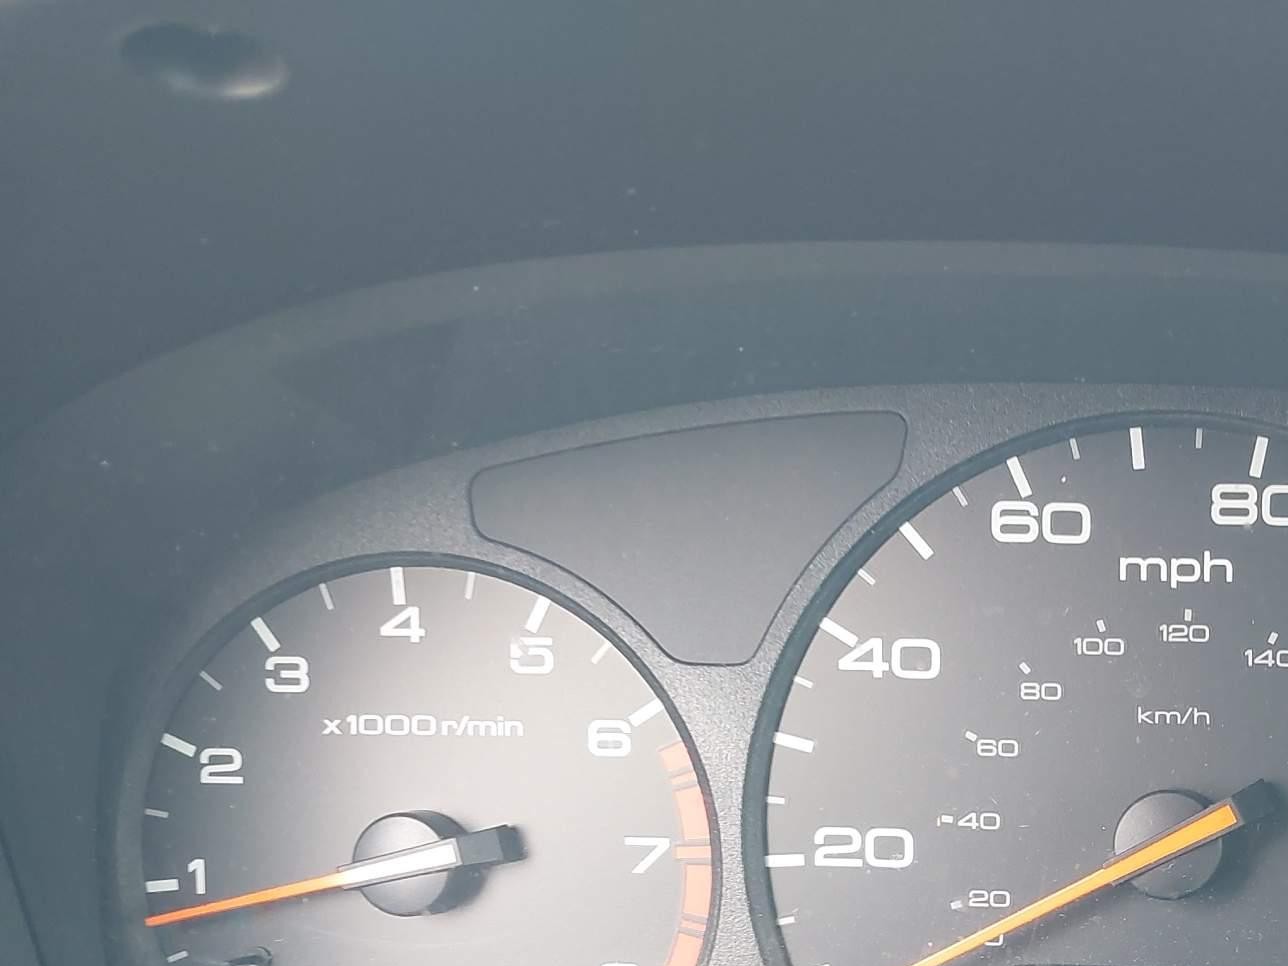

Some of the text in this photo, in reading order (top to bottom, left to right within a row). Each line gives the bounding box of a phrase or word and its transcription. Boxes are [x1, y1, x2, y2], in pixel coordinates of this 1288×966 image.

[991, 502, 1092, 544] 60
[1119, 551, 1233, 589] mph
[379, 606, 426, 643] 4
[1159, 624, 1210, 642] 120
[510, 636, 554, 676] 5
[838, 637, 941, 679] 40
[1073, 638, 1125, 656] 100
[264, 655, 311, 693] 3
[1020, 683, 1062, 701] 80
[321, 713, 525, 737] x1000 r/min
[1137, 706, 1211, 726] km/h
[587, 719, 632, 757] 6
[976, 739, 1019, 757] 60
[199, 748, 245, 784] 2
[957, 812, 1001, 830] 40
[623, 836, 671, 874] 7
[813, 827, 914, 868] 20
[187, 858, 207, 895] 1
[968, 890, 1011, 908] 20
